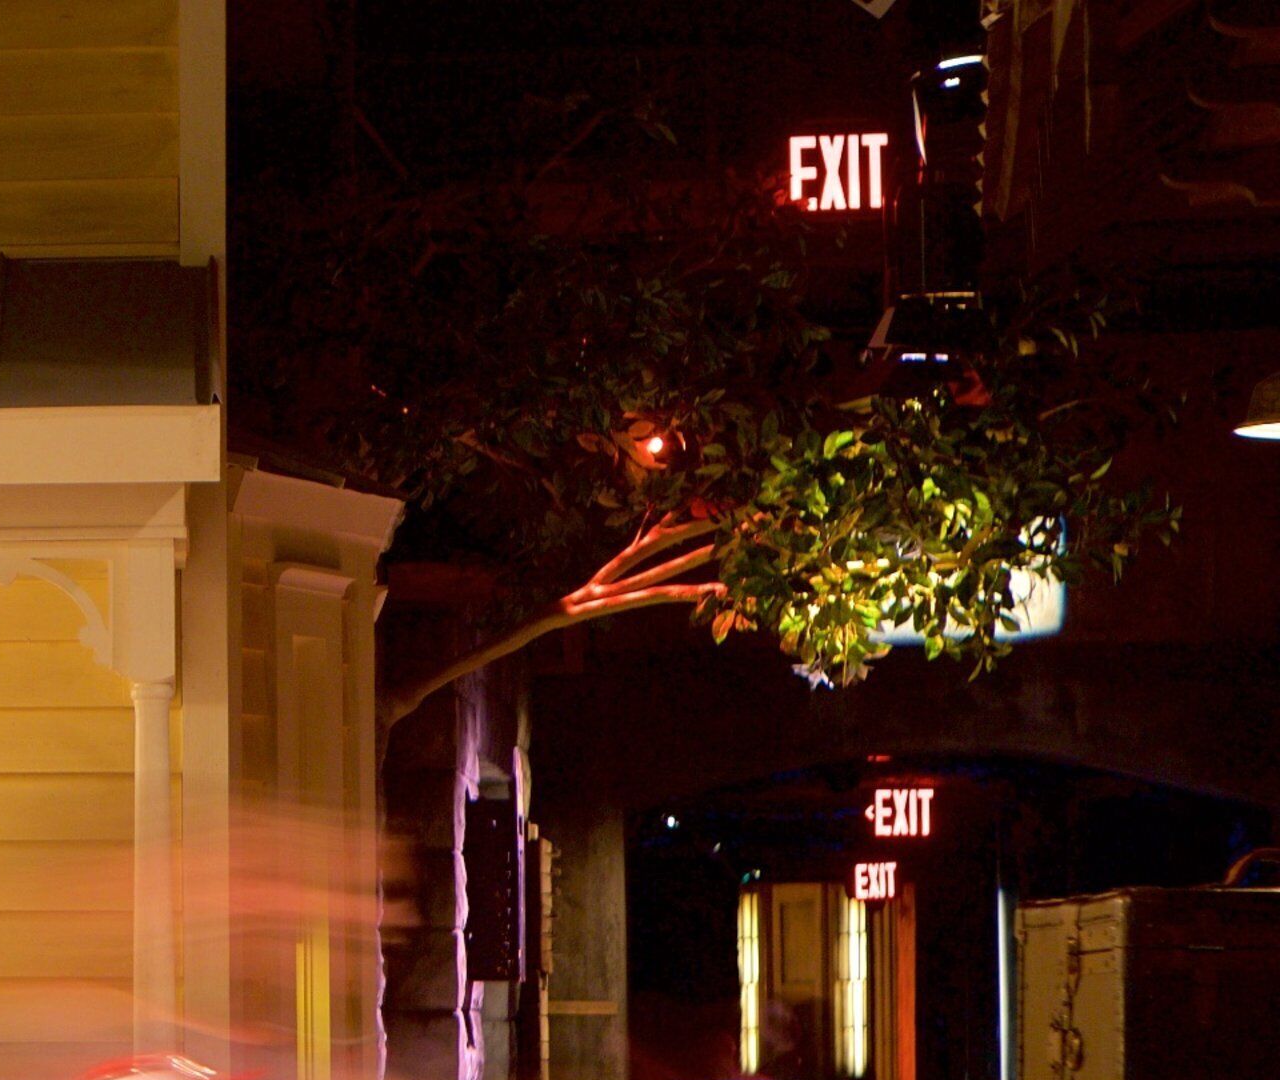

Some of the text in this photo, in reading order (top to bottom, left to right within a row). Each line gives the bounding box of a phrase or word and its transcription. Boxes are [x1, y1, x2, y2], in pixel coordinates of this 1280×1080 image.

[789, 132, 889, 211] EXIT
[875, 789, 934, 836] EXIT
[855, 862, 897, 899] EXIT
